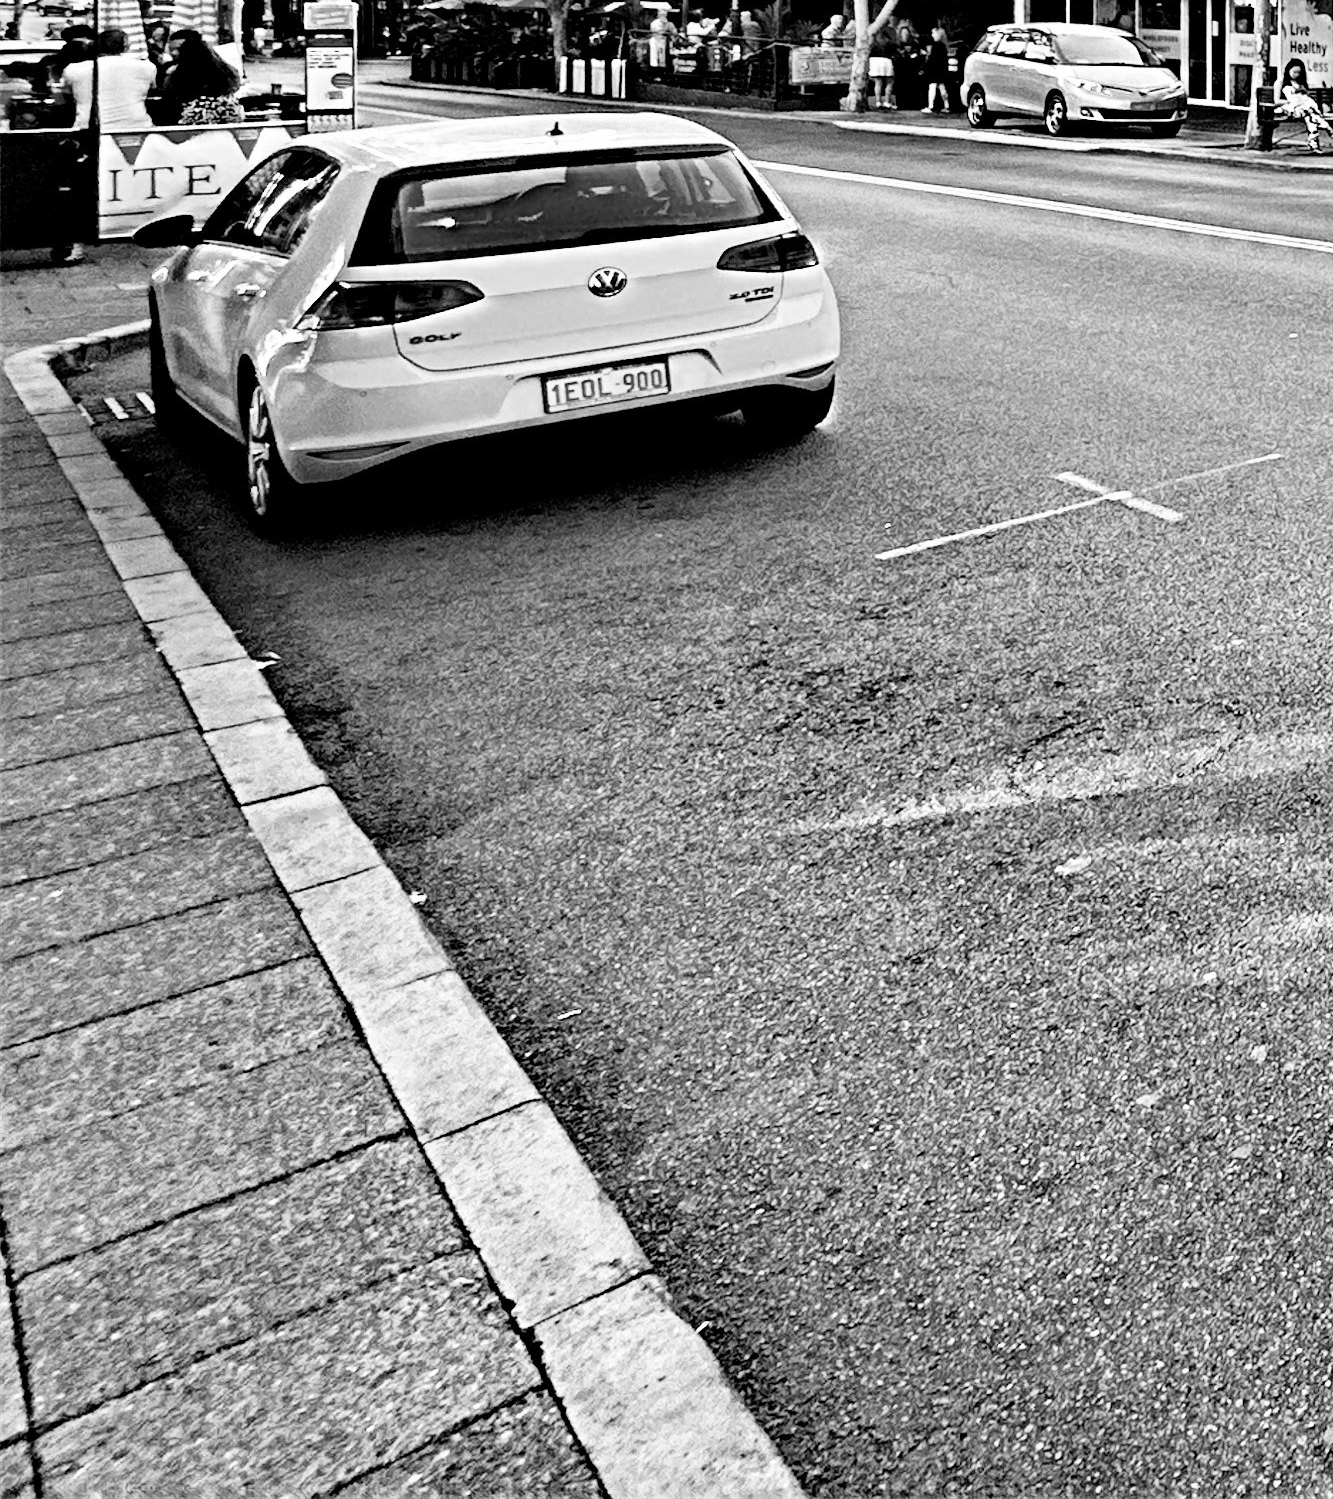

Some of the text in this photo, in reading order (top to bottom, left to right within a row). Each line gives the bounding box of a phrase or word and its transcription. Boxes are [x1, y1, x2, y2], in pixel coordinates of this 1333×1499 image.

[1289, 22, 1310, 37] Live
[1289, 40, 1328, 57] Healthy
[1306, 60, 1329, 74] Less
[108, 164, 221, 202] ITE
[409, 332, 462, 345] GOLF
